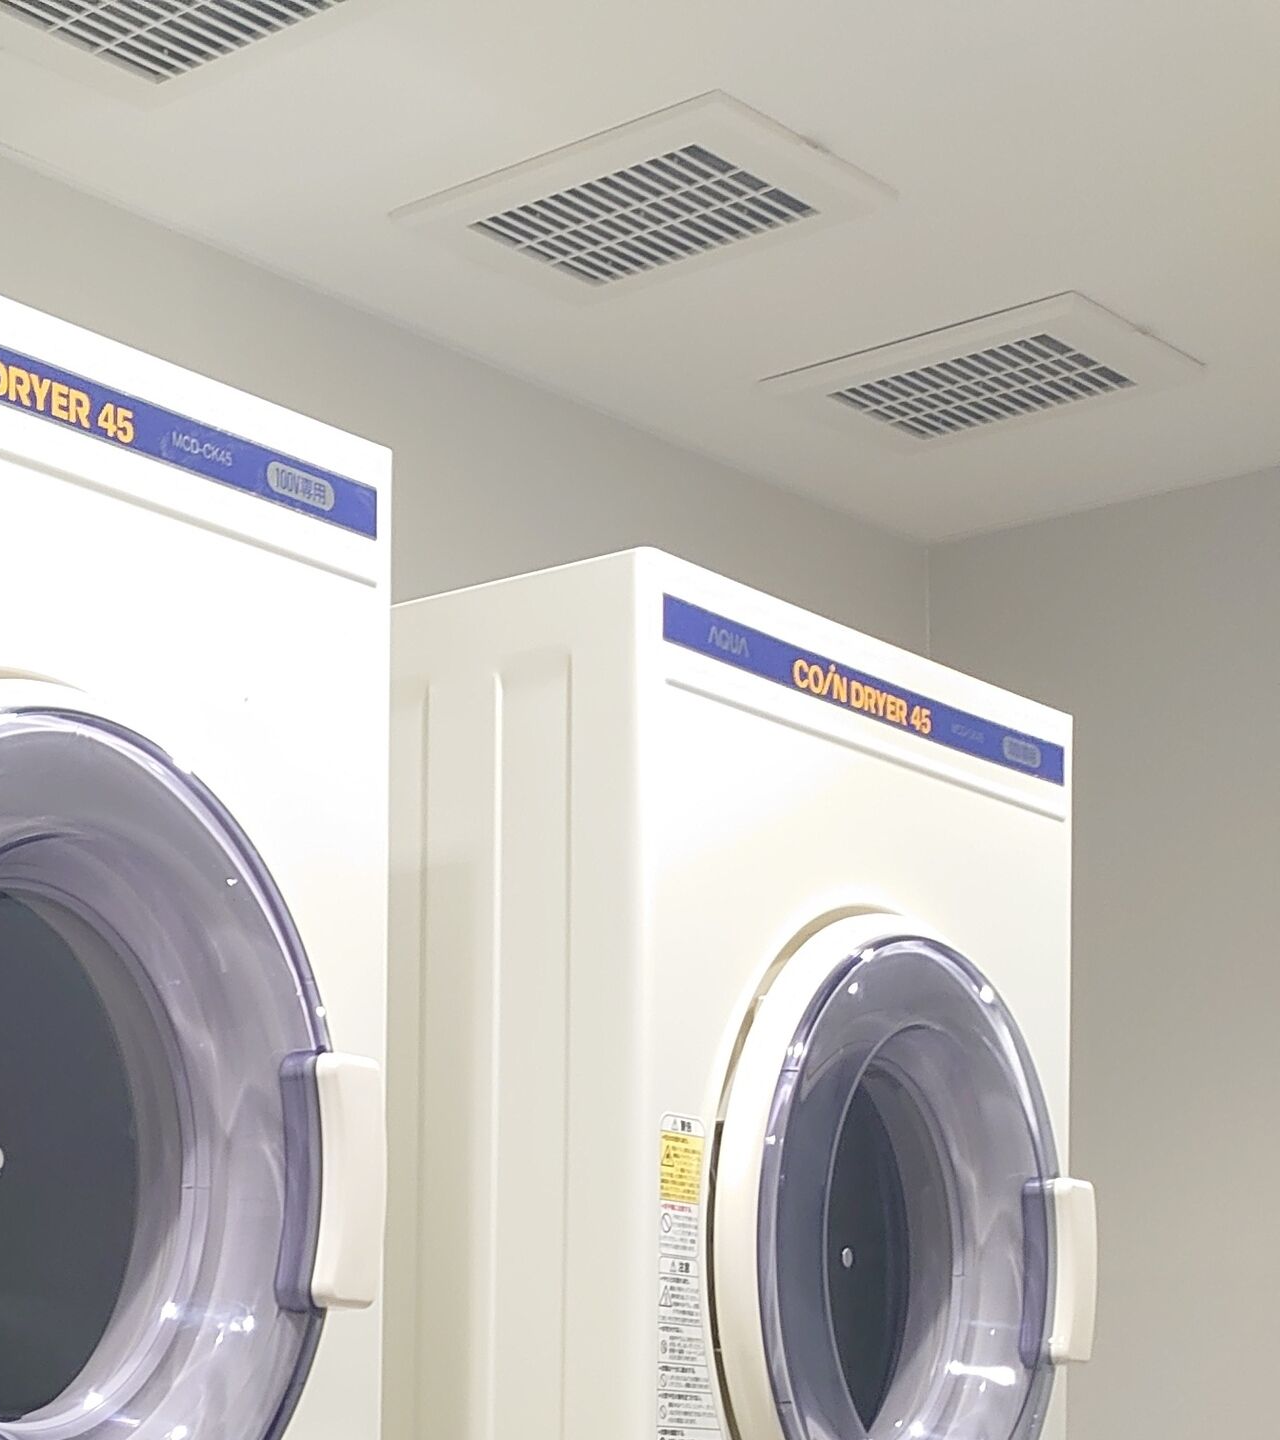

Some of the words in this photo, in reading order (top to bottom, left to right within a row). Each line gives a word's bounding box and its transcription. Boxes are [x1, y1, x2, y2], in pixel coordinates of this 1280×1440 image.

[97, 402, 135, 444] 45
[850, 679, 908, 726] DRYER
[910, 705, 932, 735] 45
